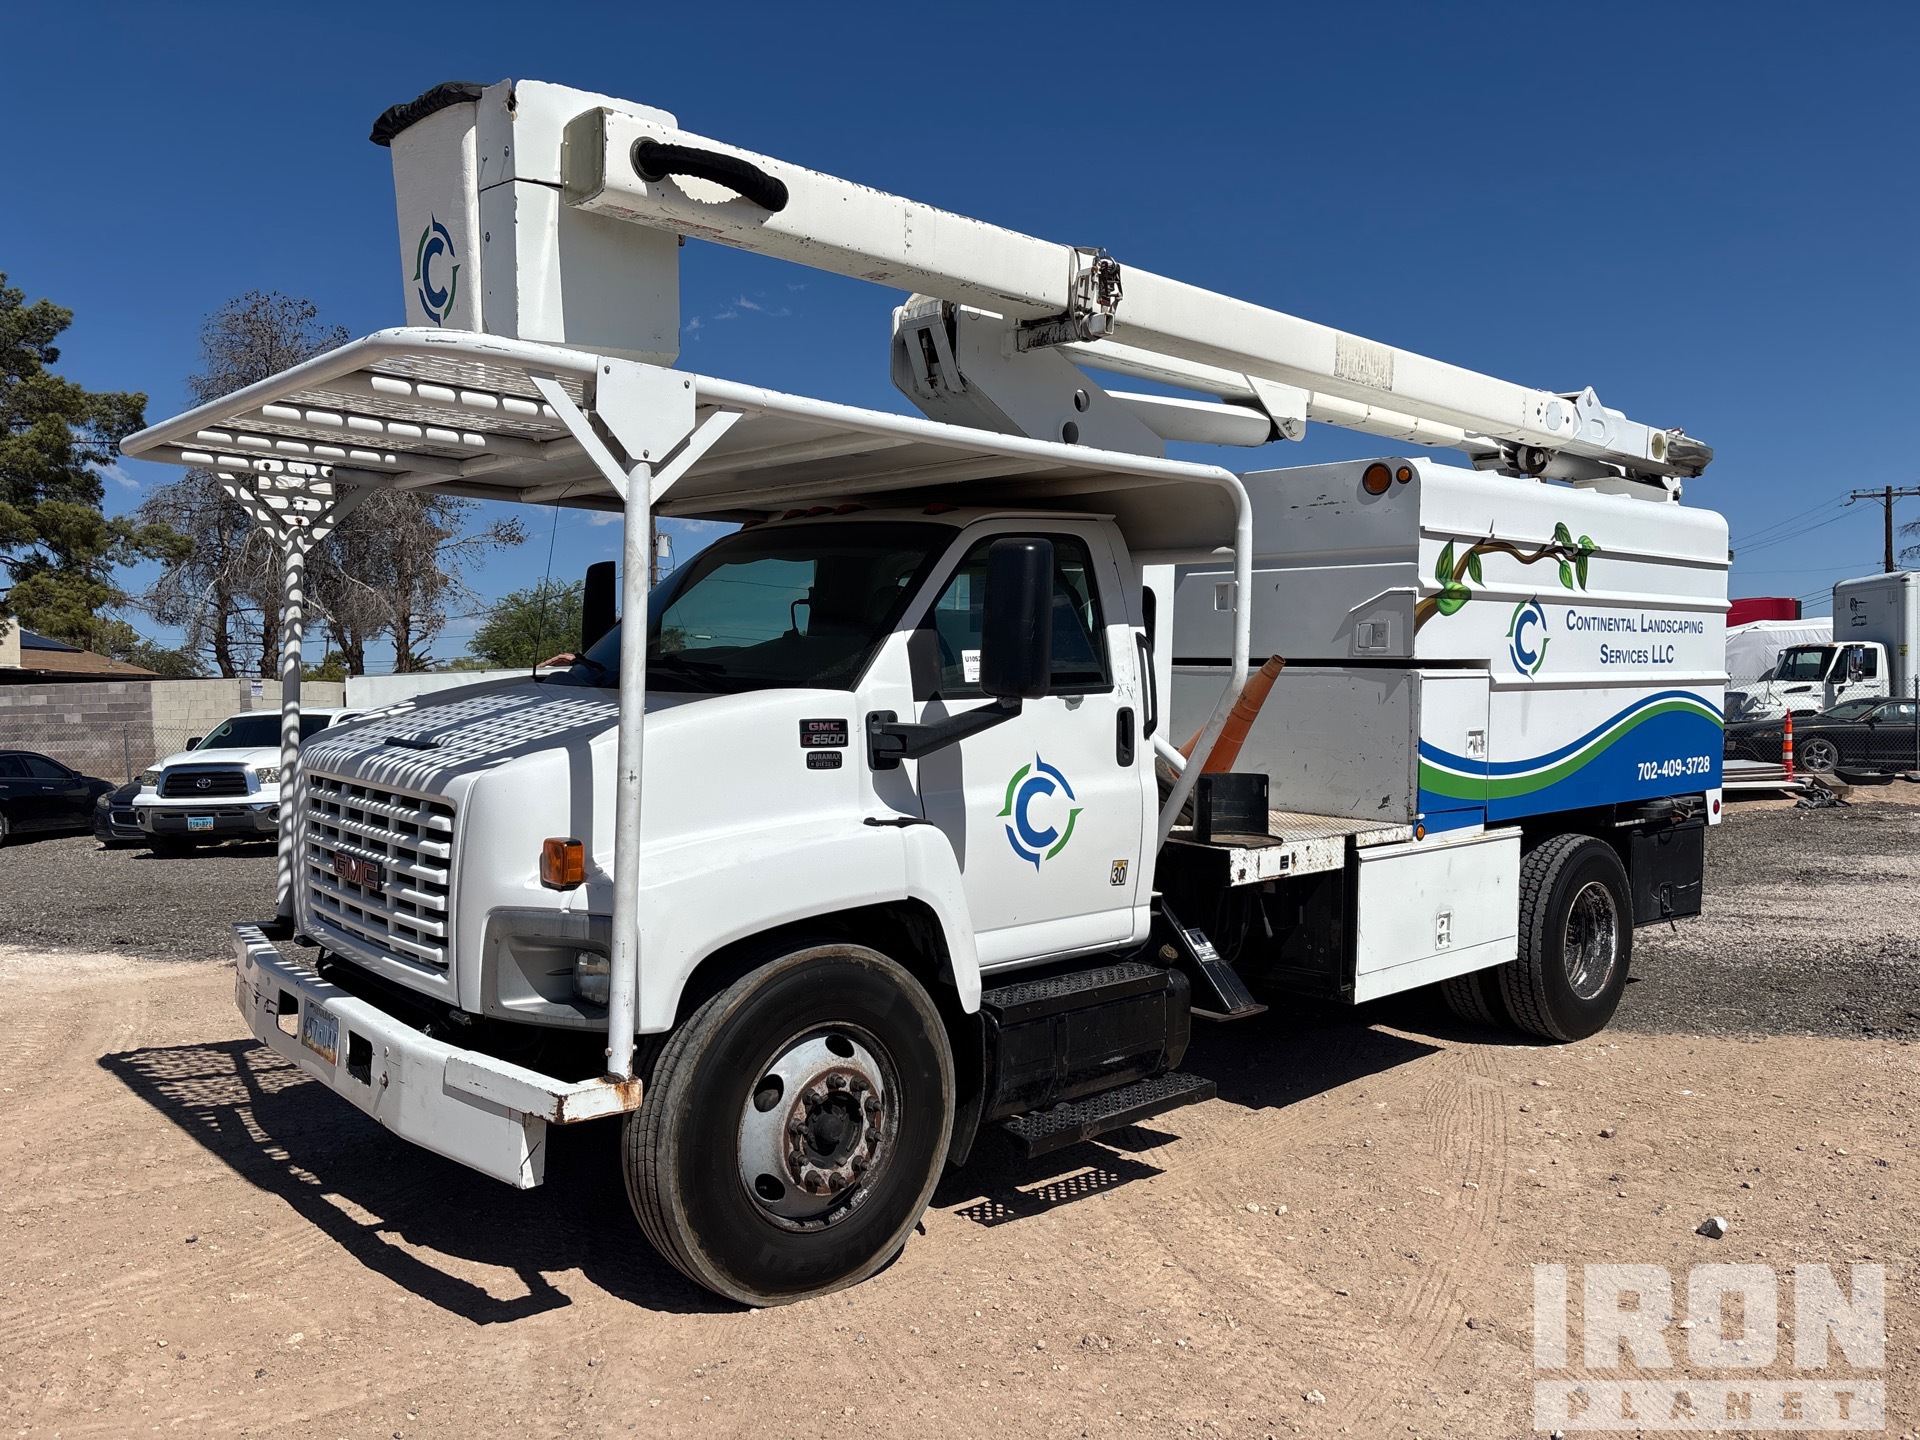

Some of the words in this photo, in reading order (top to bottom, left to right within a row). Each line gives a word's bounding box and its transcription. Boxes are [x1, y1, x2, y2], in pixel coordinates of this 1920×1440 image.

[1566, 609, 1637, 632] CONTINENTAL
[1641, 613, 1703, 634] LANDSCAPING
[1600, 643, 1648, 664] SERVICES
[1652, 644, 1674, 664] LLC
[808, 722, 840, 731] GMC
[803, 733, 846, 745] C6500
[808, 753, 841, 761] DURAMAX
[1637, 755, 1710, 781] 702-409-3728
[1015, 776, 1059, 848] C
[333, 851, 378, 890] GMC
[1111, 866, 1126, 883] 30
